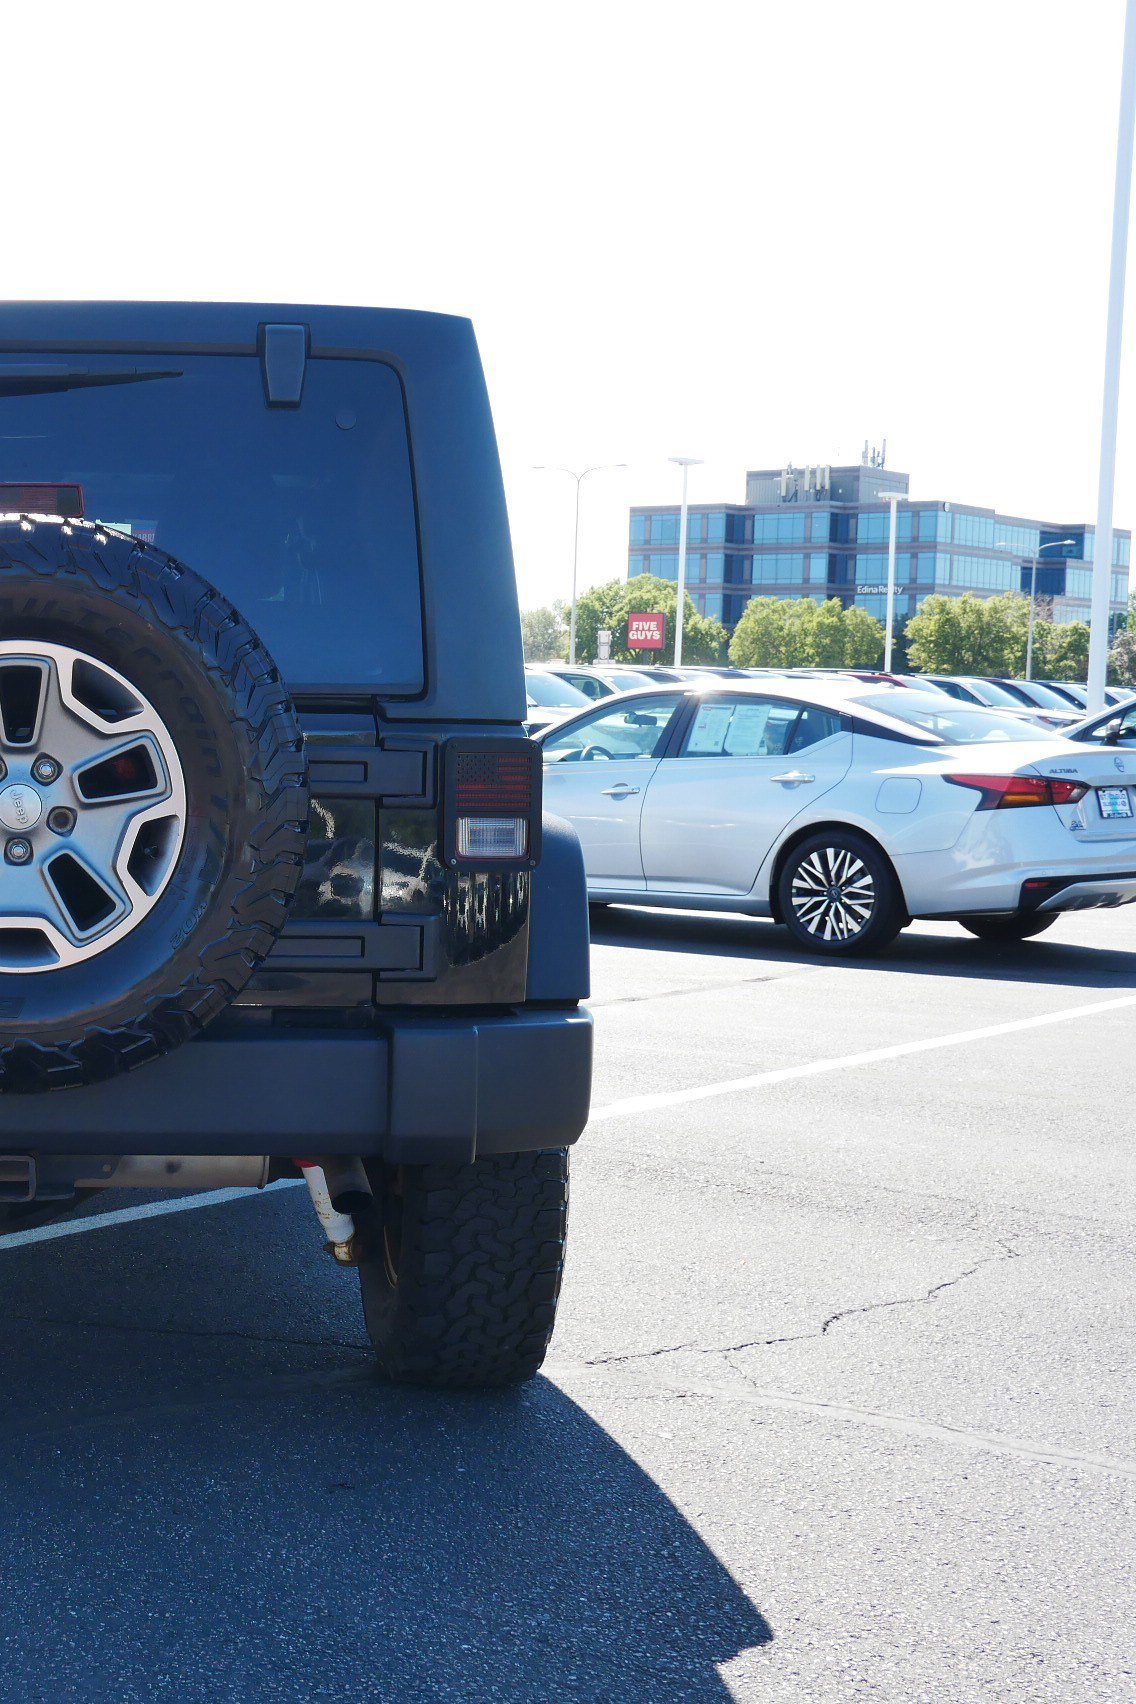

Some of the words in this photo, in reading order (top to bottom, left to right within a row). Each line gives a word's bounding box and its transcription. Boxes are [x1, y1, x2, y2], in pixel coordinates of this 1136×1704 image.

[857, 585, 878, 594] Edina
[878, 585, 903, 595] Rety
[632, 621, 658, 631] FIVE
[628, 630, 661, 640] GUYS
[9, 789, 29, 824] Jeep
